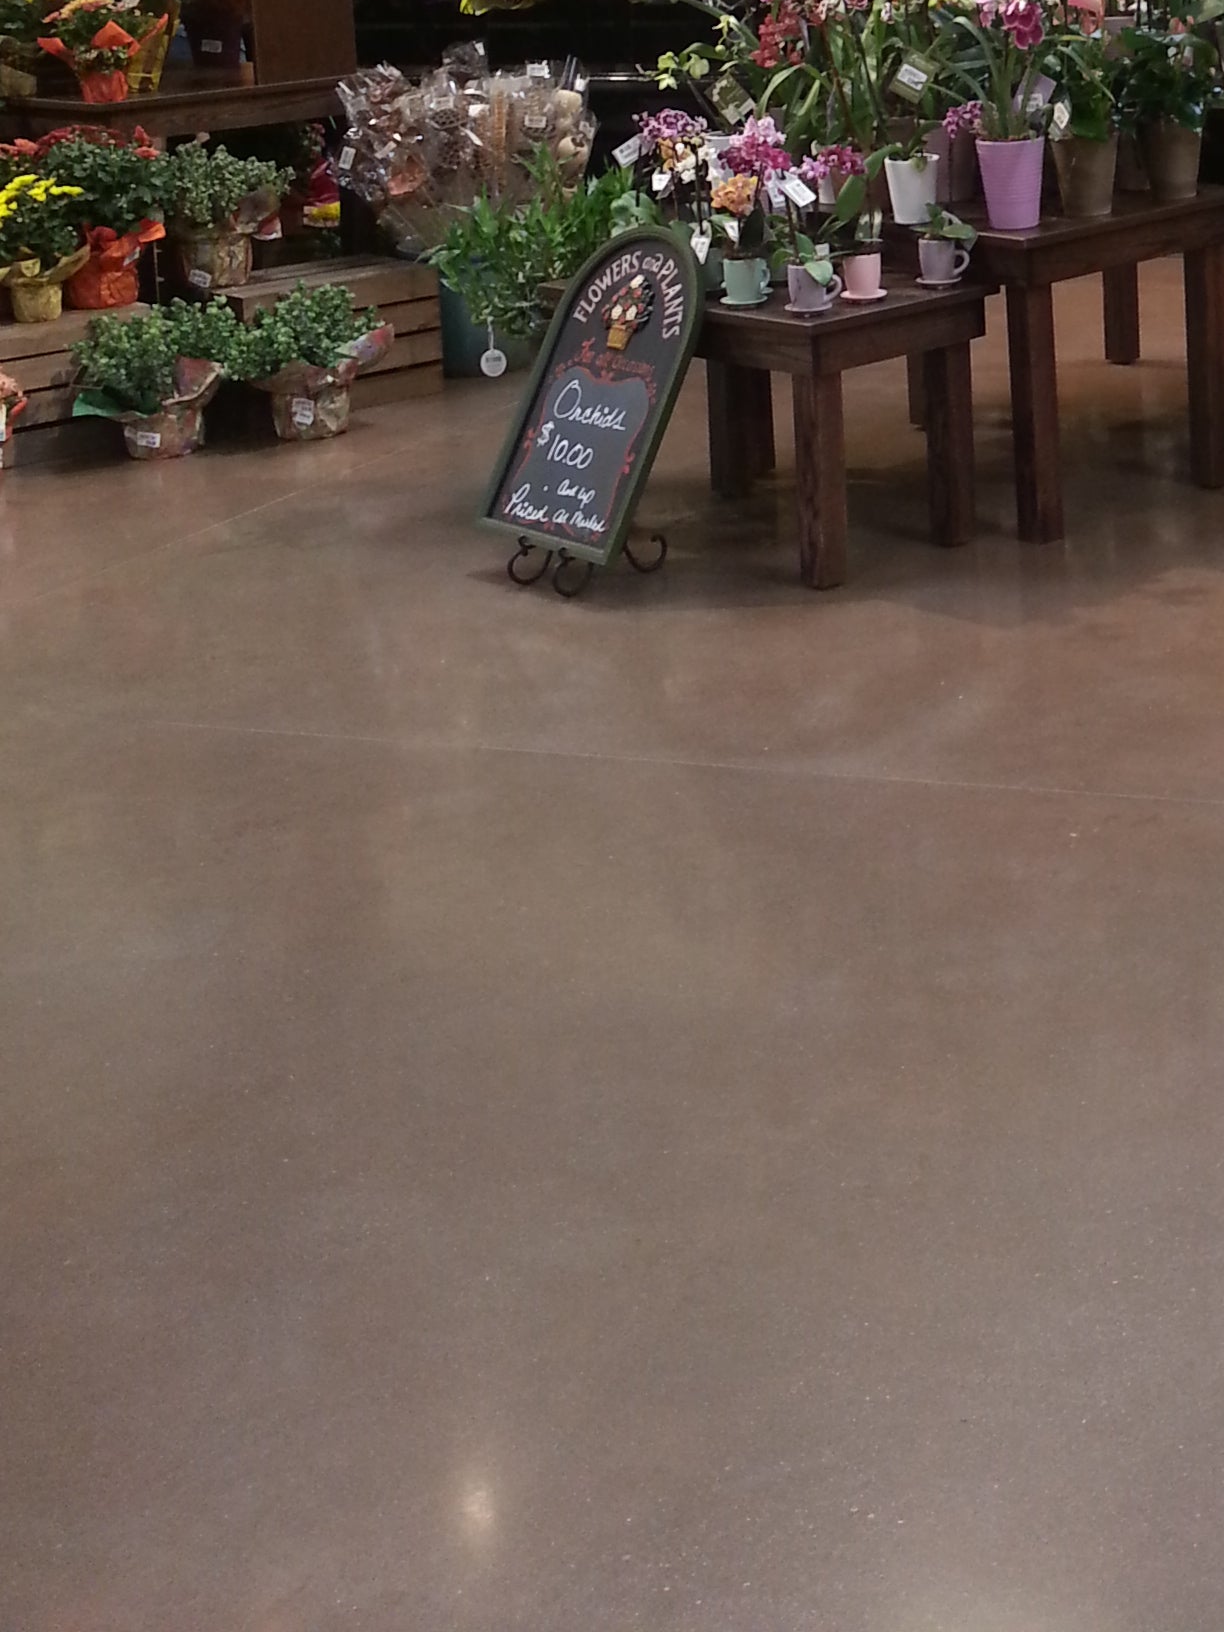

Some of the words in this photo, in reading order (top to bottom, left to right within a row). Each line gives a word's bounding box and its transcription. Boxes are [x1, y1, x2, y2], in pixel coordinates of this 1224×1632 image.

[572, 250, 643, 324] FLOWERS
[655, 258, 684, 340] PLANTS
[553, 379, 627, 431] Orchids
